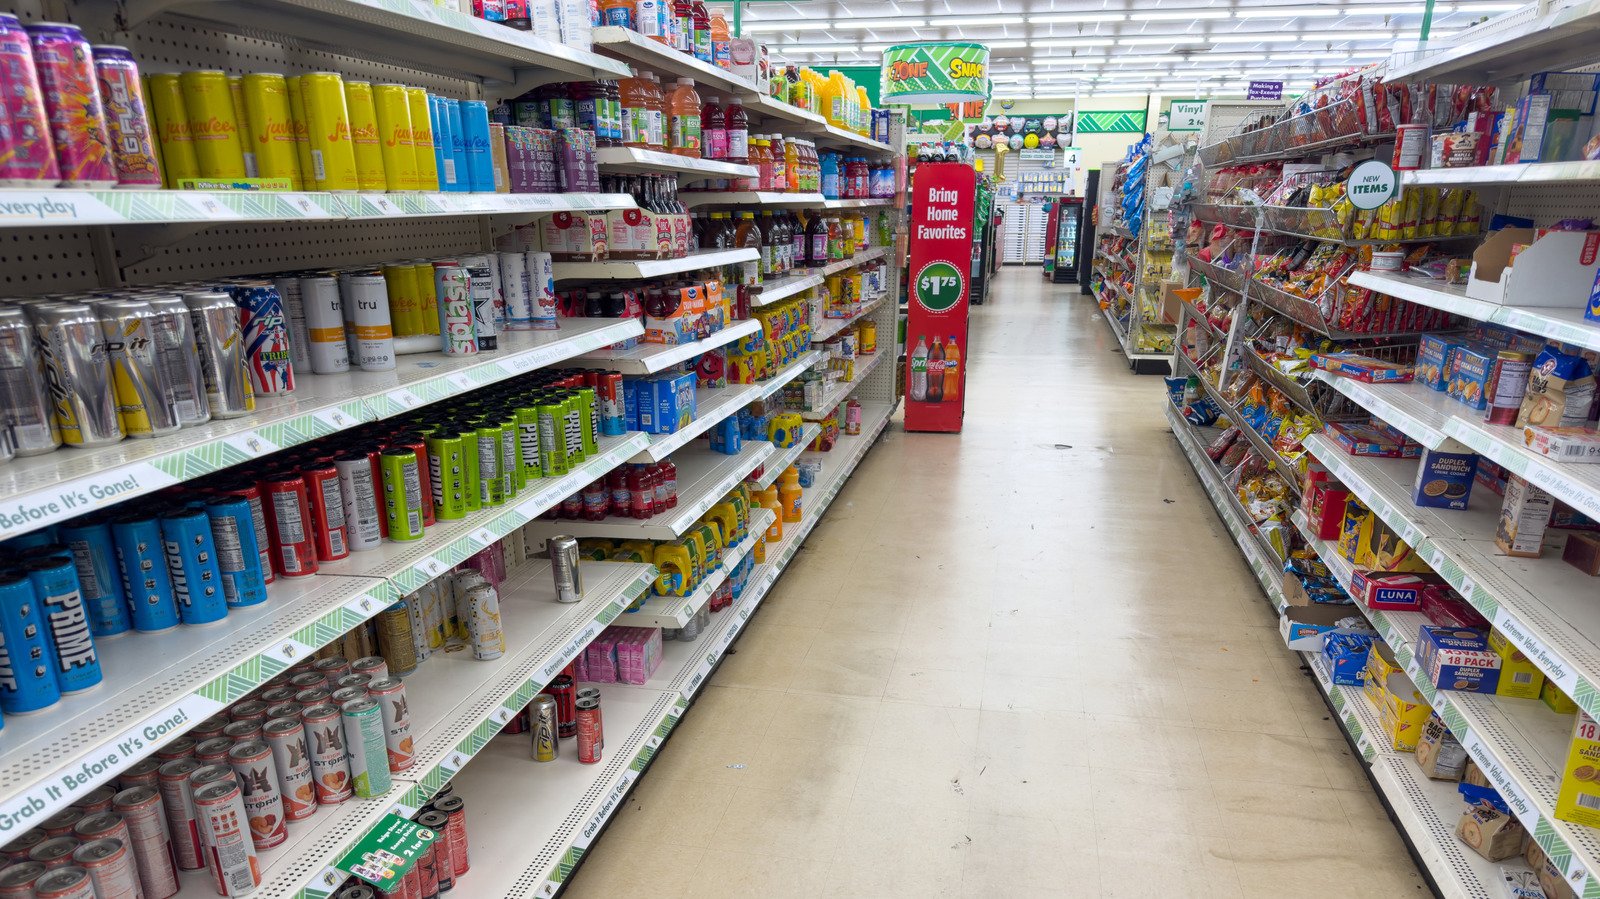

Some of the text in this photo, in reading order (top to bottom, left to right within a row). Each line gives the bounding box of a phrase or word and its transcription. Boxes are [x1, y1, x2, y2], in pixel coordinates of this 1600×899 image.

[0, 42, 27, 54] UEL
[893, 60, 928, 81] ZONE
[1178, 105, 1203, 114] Vinyl
[192, 118, 236, 134] uvee
[1068, 154, 1076, 164] 4
[1362, 175, 1381, 183] NEW
[928, 188, 958, 205] Bring
[1353, 184, 1388, 194] ITEMS
[0, 198, 77, 218] veryday
[927, 206, 958, 220] Home
[918, 224, 966, 240] Favorites
[331, 300, 340, 310] tr
[358, 300, 377, 310] tru
[912, 357, 928, 369] Spri
[518, 422, 540, 468] PRIME
[1431, 463, 1471, 472] SANDWICH
[1438, 458, 1466, 466] DUPLEX
[0, 474, 140, 530] Before It's Gone!
[1584, 497, 1600, 512] Gone
[1354, 573, 1364, 588] LUNA
[1380, 590, 1413, 600] LUNA
[45, 588, 96, 673] PRIME
[544, 628, 594, 676] Extreme Value Everyday
[1503, 618, 1566, 680] Extreme Value Everyday
[1448, 656, 1494, 668] 18 PACK
[692, 672, 702, 688] ITEMS
[1428, 721, 1443, 734] BAG
[1580, 723, 1596, 740] 18
[322, 752, 341, 760] REIGN
[1578, 748, 1600, 758] SAND
[0, 708, 189, 832] Grab It Before It's Gone!
[1470, 742, 1529, 816] Extreme Value Everyday
[584, 822, 598, 838] Grab
[598, 800, 614, 819] Before
[610, 792, 619, 802] It's
[616, 776, 630, 794] Gone!
[377, 831, 391, 843] Reign
[390, 824, 418, 850] Energy Drinks
[403, 840, 423, 857] 2 for
